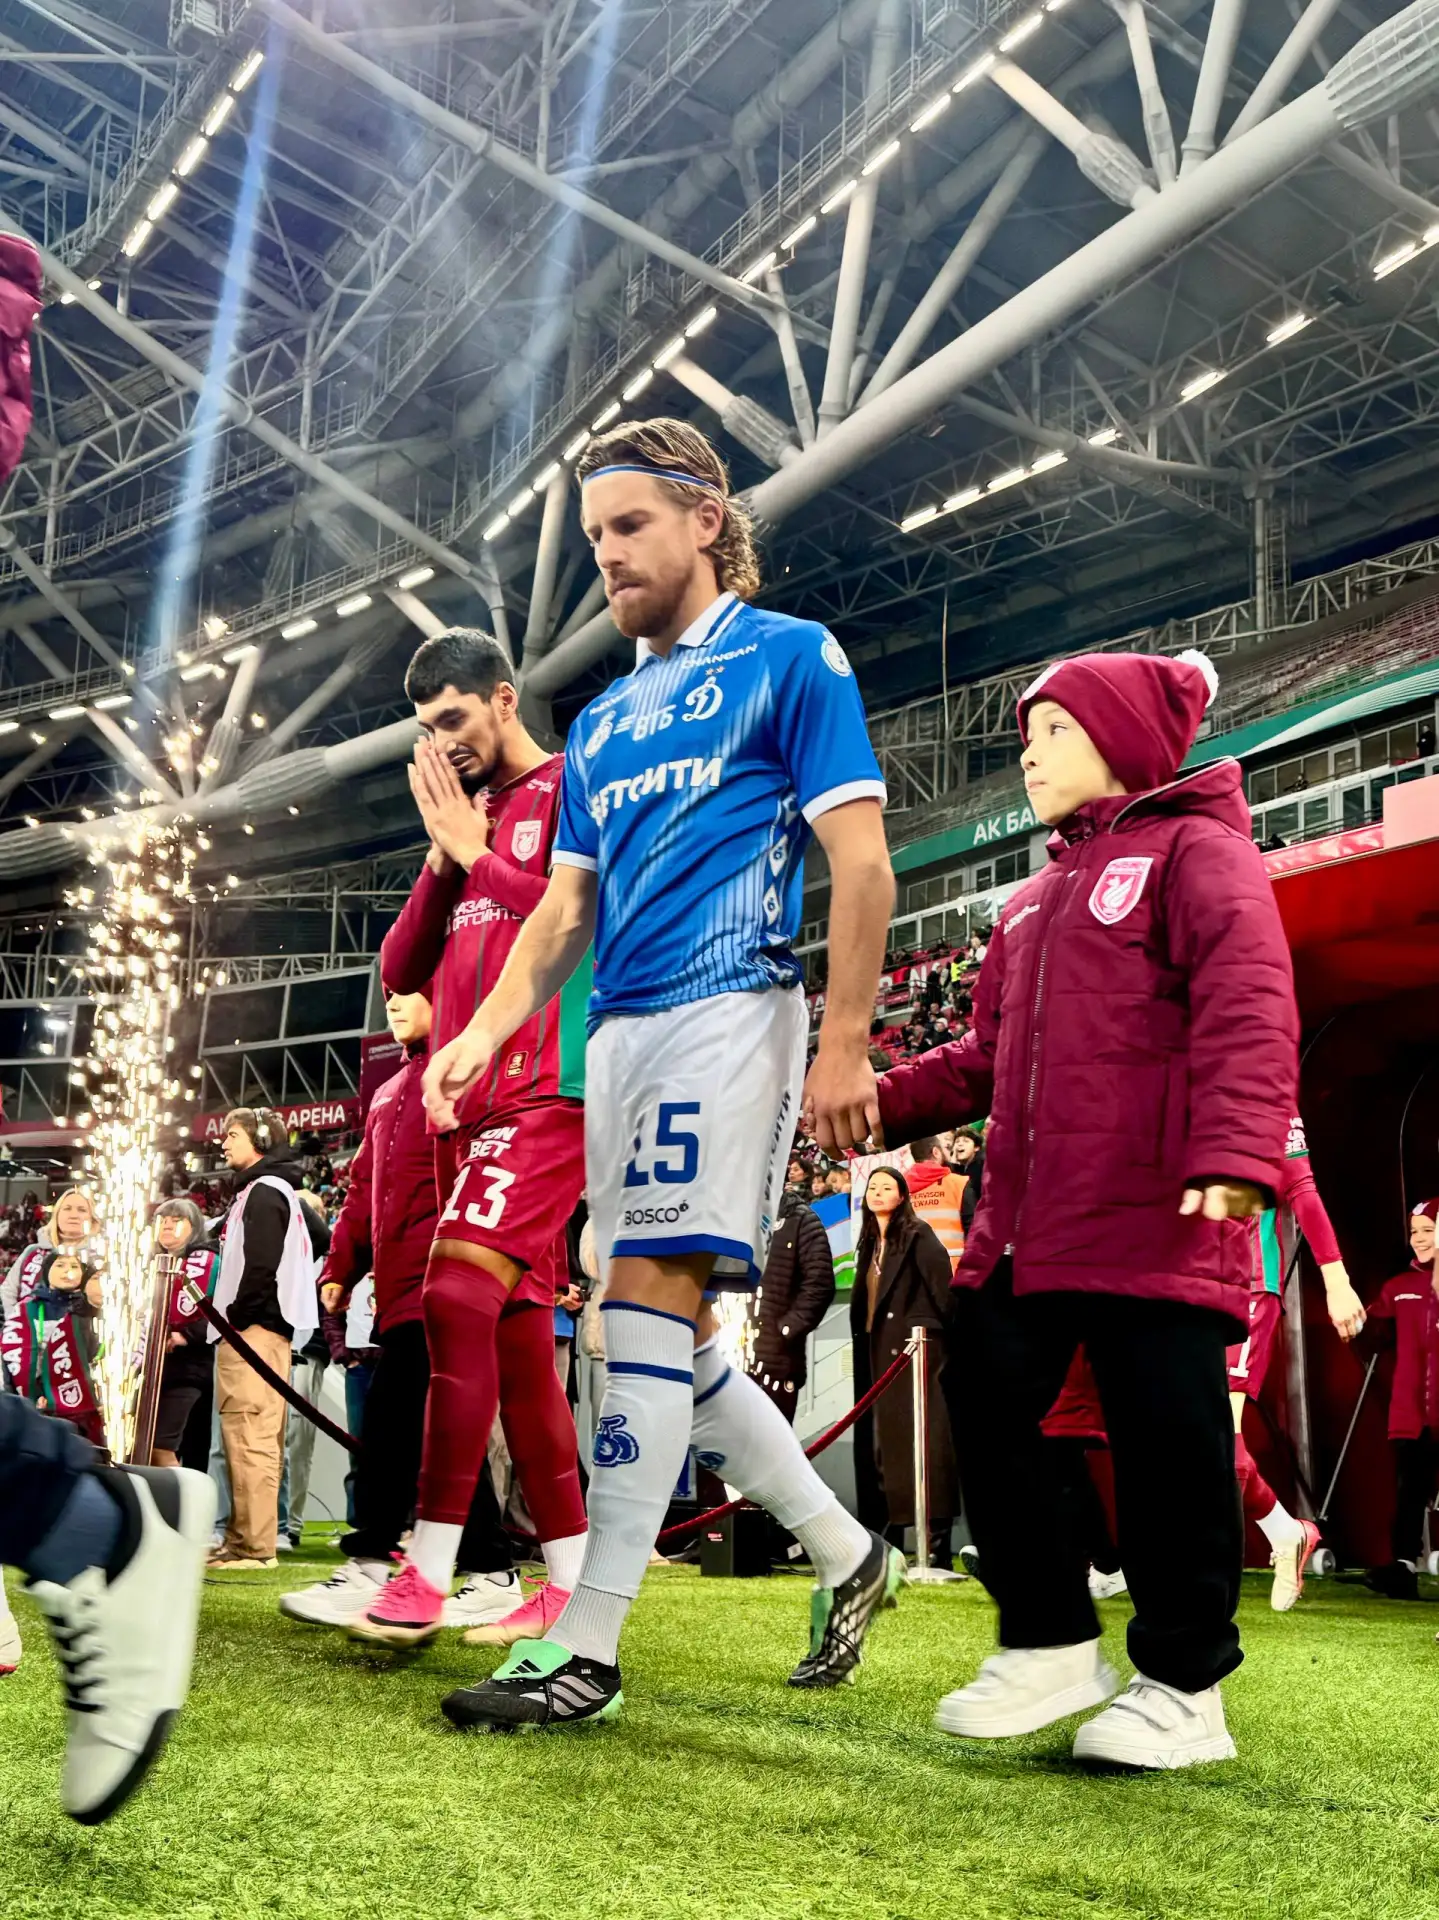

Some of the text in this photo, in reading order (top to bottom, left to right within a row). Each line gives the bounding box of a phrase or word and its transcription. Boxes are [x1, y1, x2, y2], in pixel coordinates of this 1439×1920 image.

[973, 804, 1040, 846] АК БА
[286, 1104, 346, 1128] АРЕНА
[468, 1140, 512, 1159] BET
[440, 1165, 516, 1230] 13
[624, 1207, 680, 1226] BOSCO
